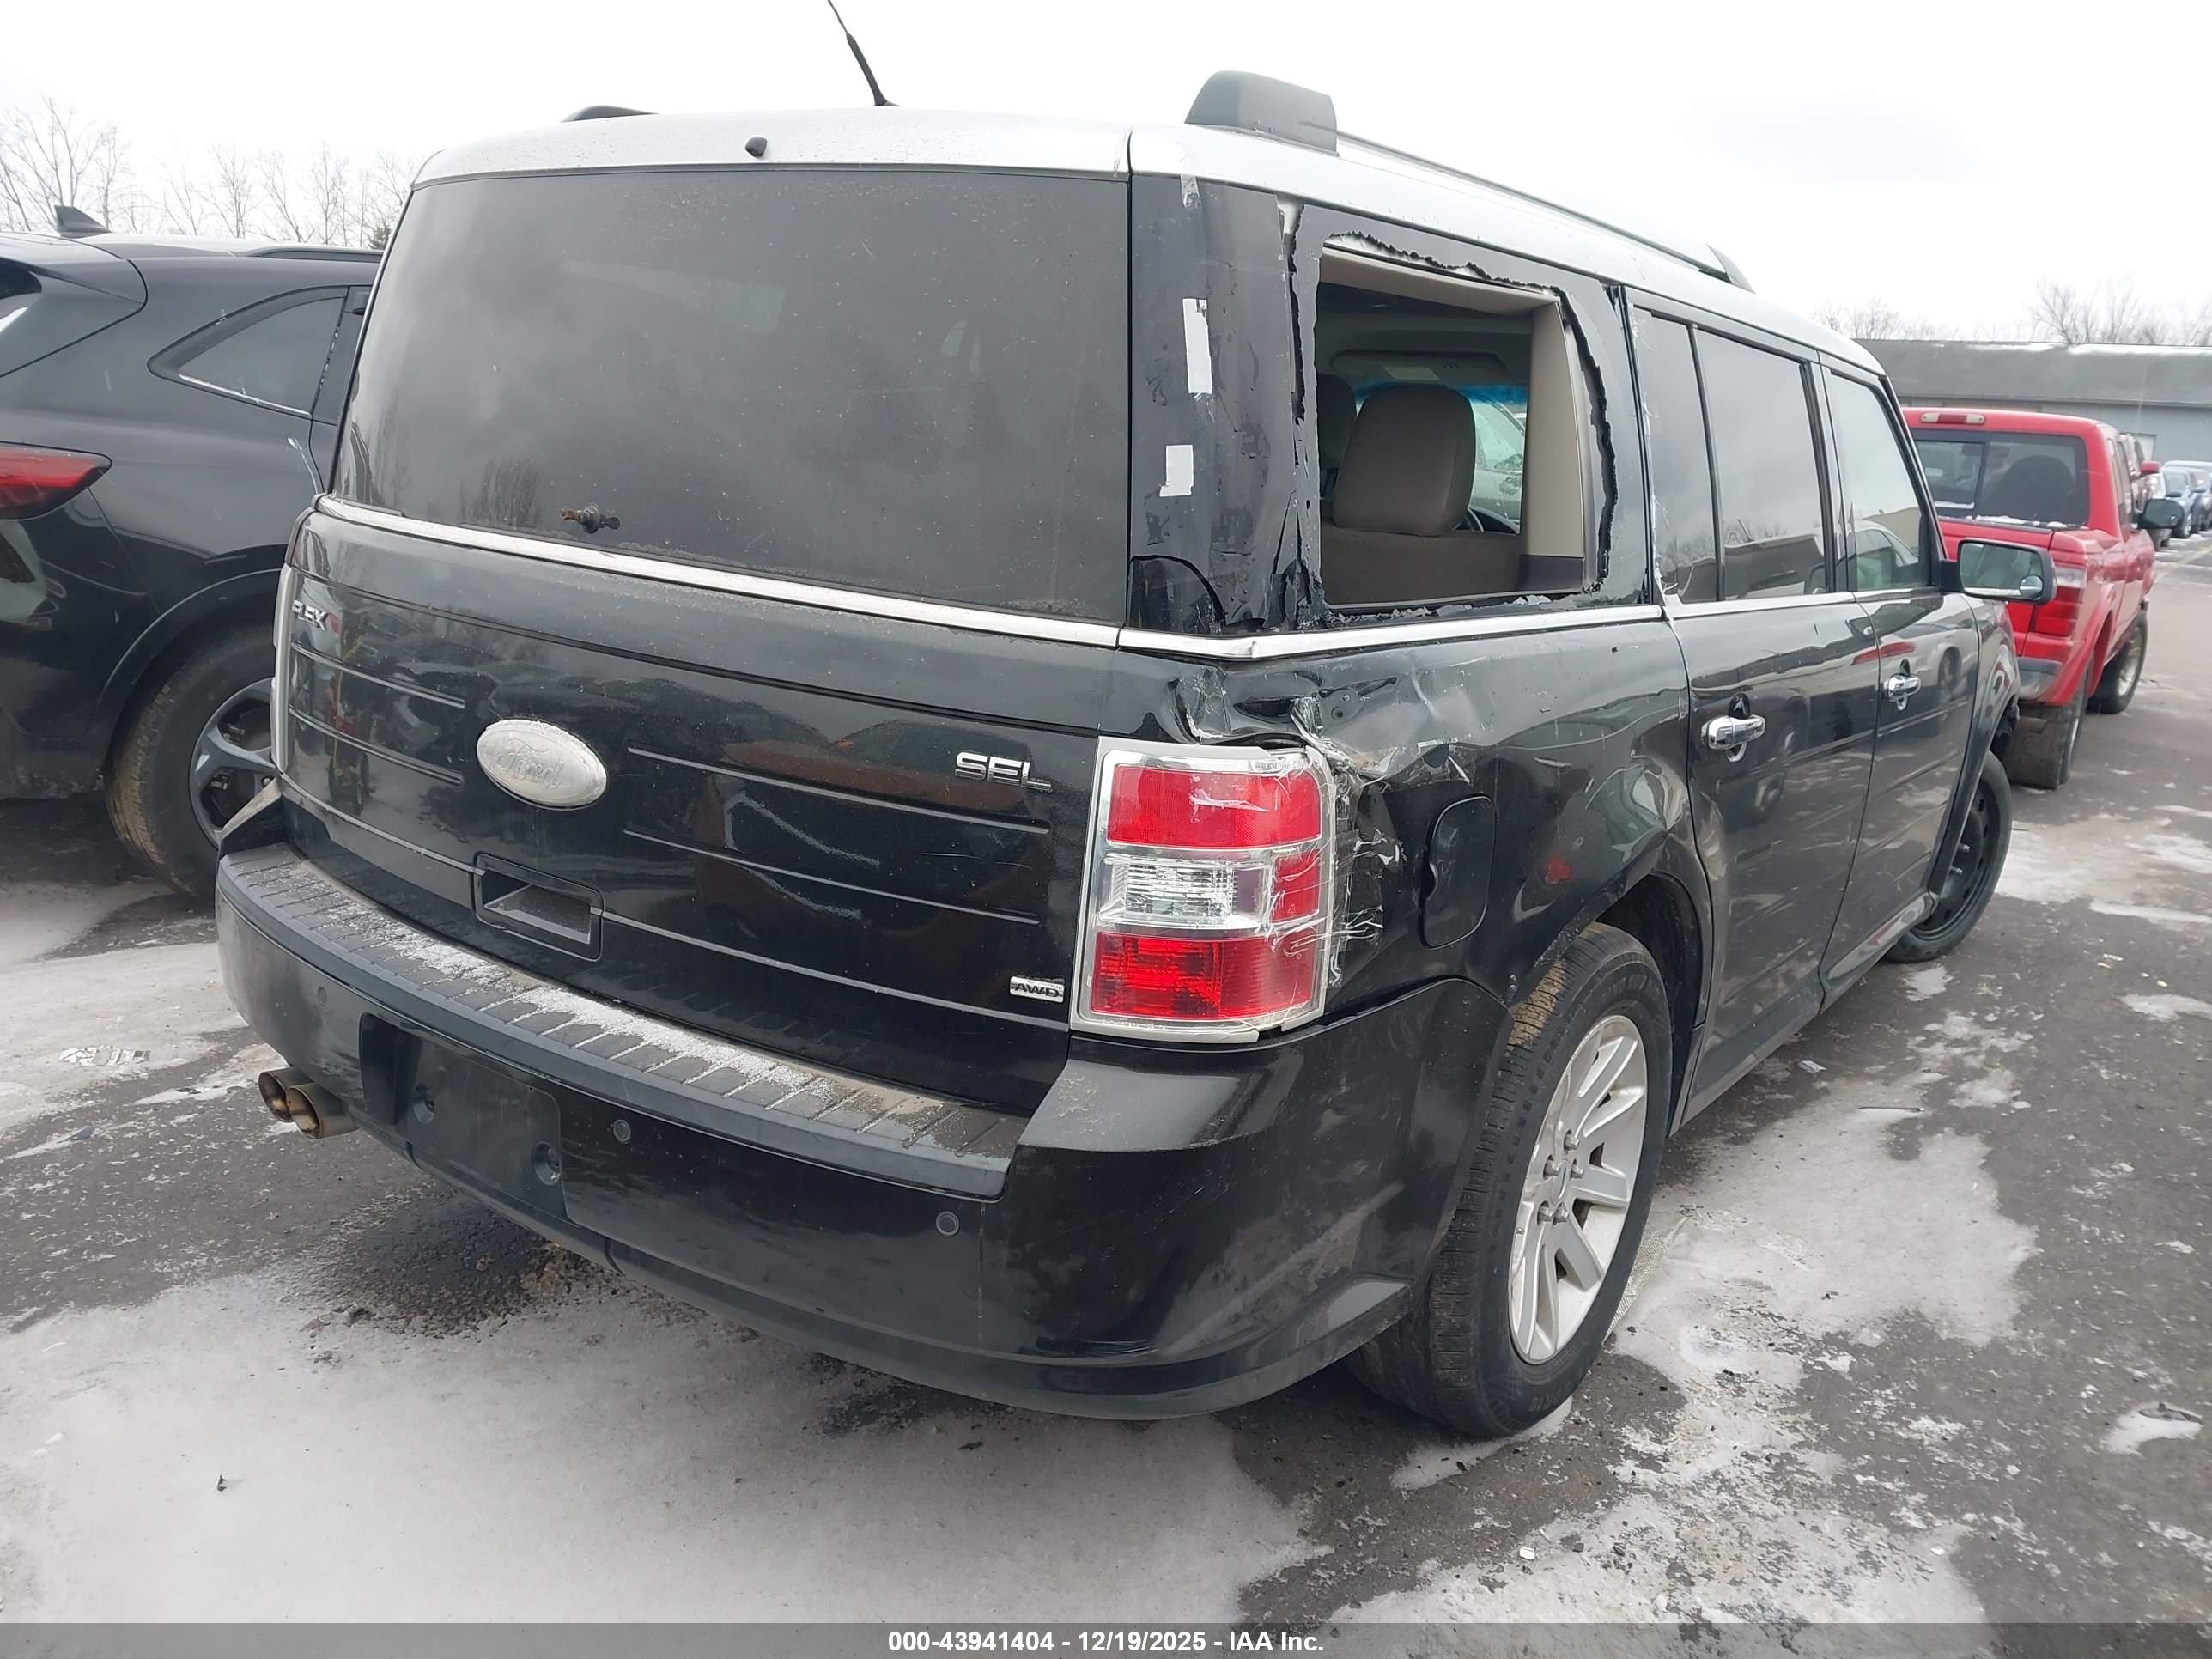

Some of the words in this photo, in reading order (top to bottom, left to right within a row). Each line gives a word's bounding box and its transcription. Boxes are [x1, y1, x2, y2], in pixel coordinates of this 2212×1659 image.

[292, 599, 326, 632] FLEX
[954, 751, 1052, 792] SEL
[1013, 982, 1060, 998] AWD
